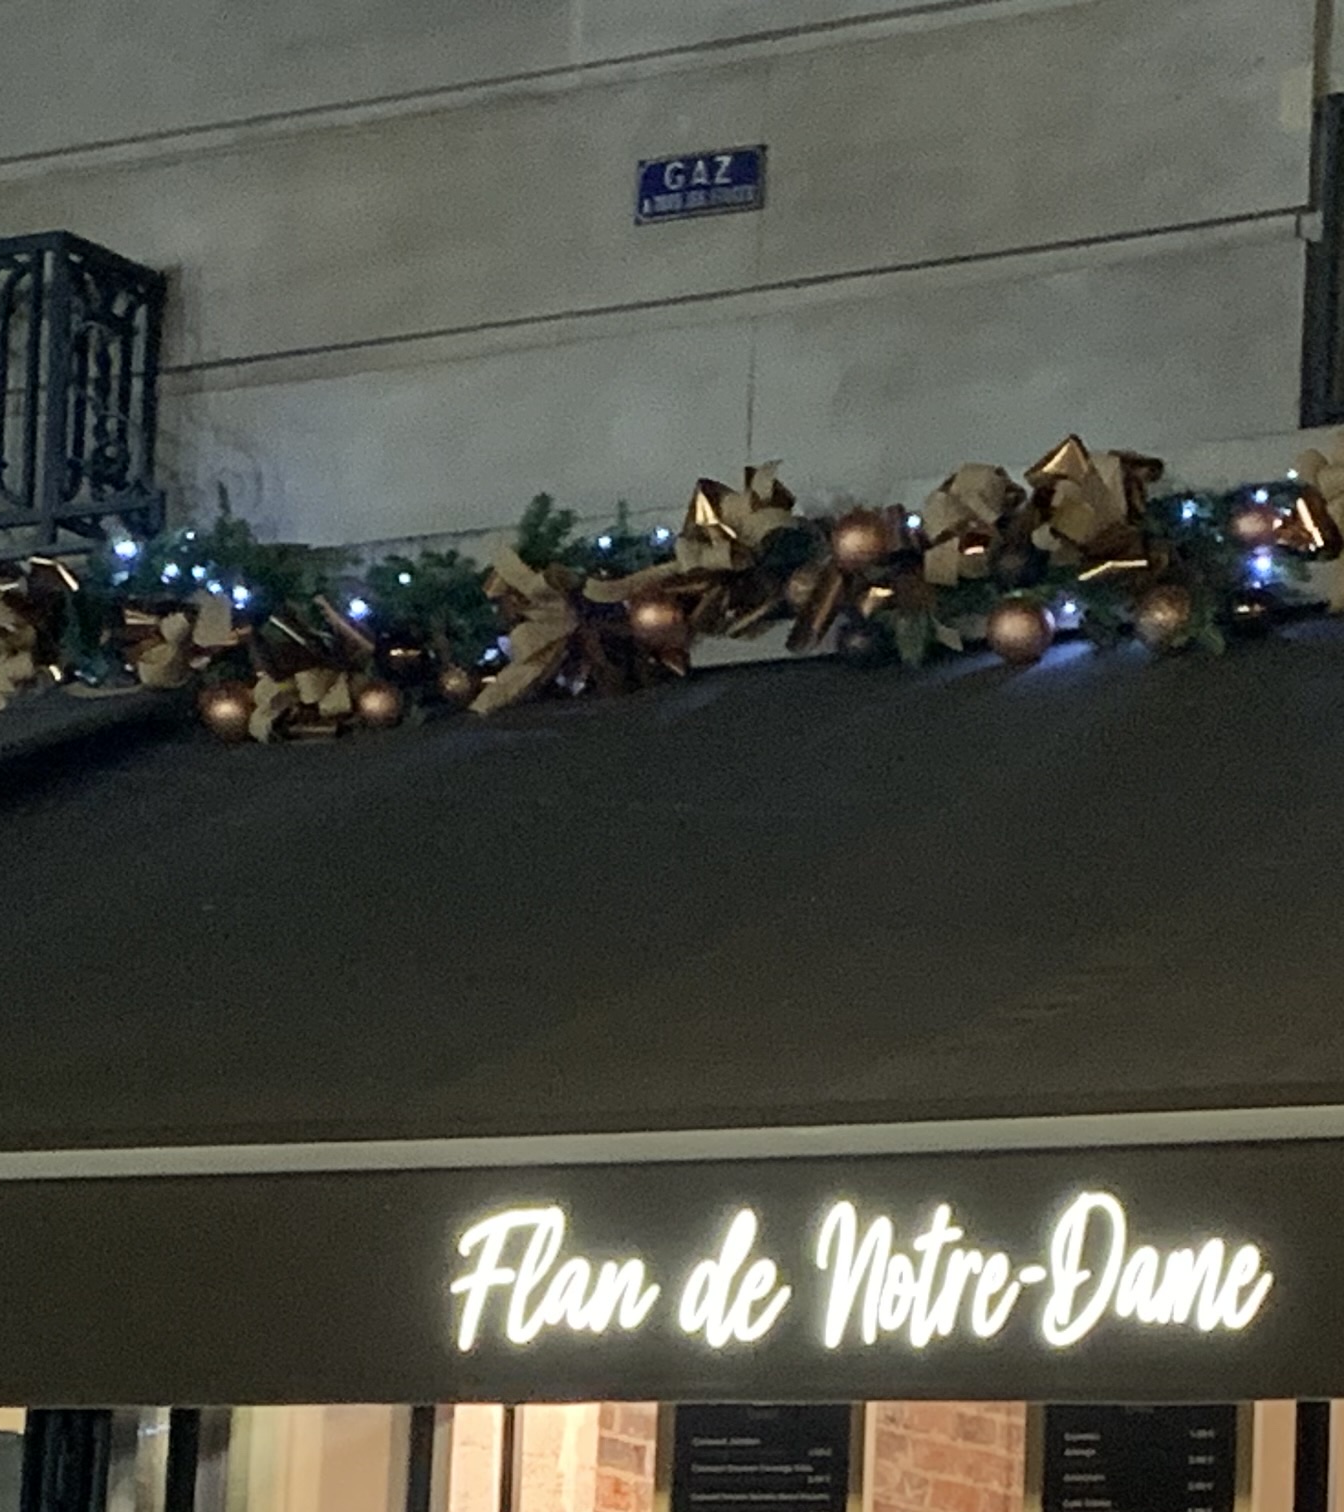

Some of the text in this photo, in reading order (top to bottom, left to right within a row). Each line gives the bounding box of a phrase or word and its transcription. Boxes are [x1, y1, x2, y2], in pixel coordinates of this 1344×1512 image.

[663, 155, 733, 190] GAZ
[450, 1190, 1273, 1352] Flan de Notre-Dame
